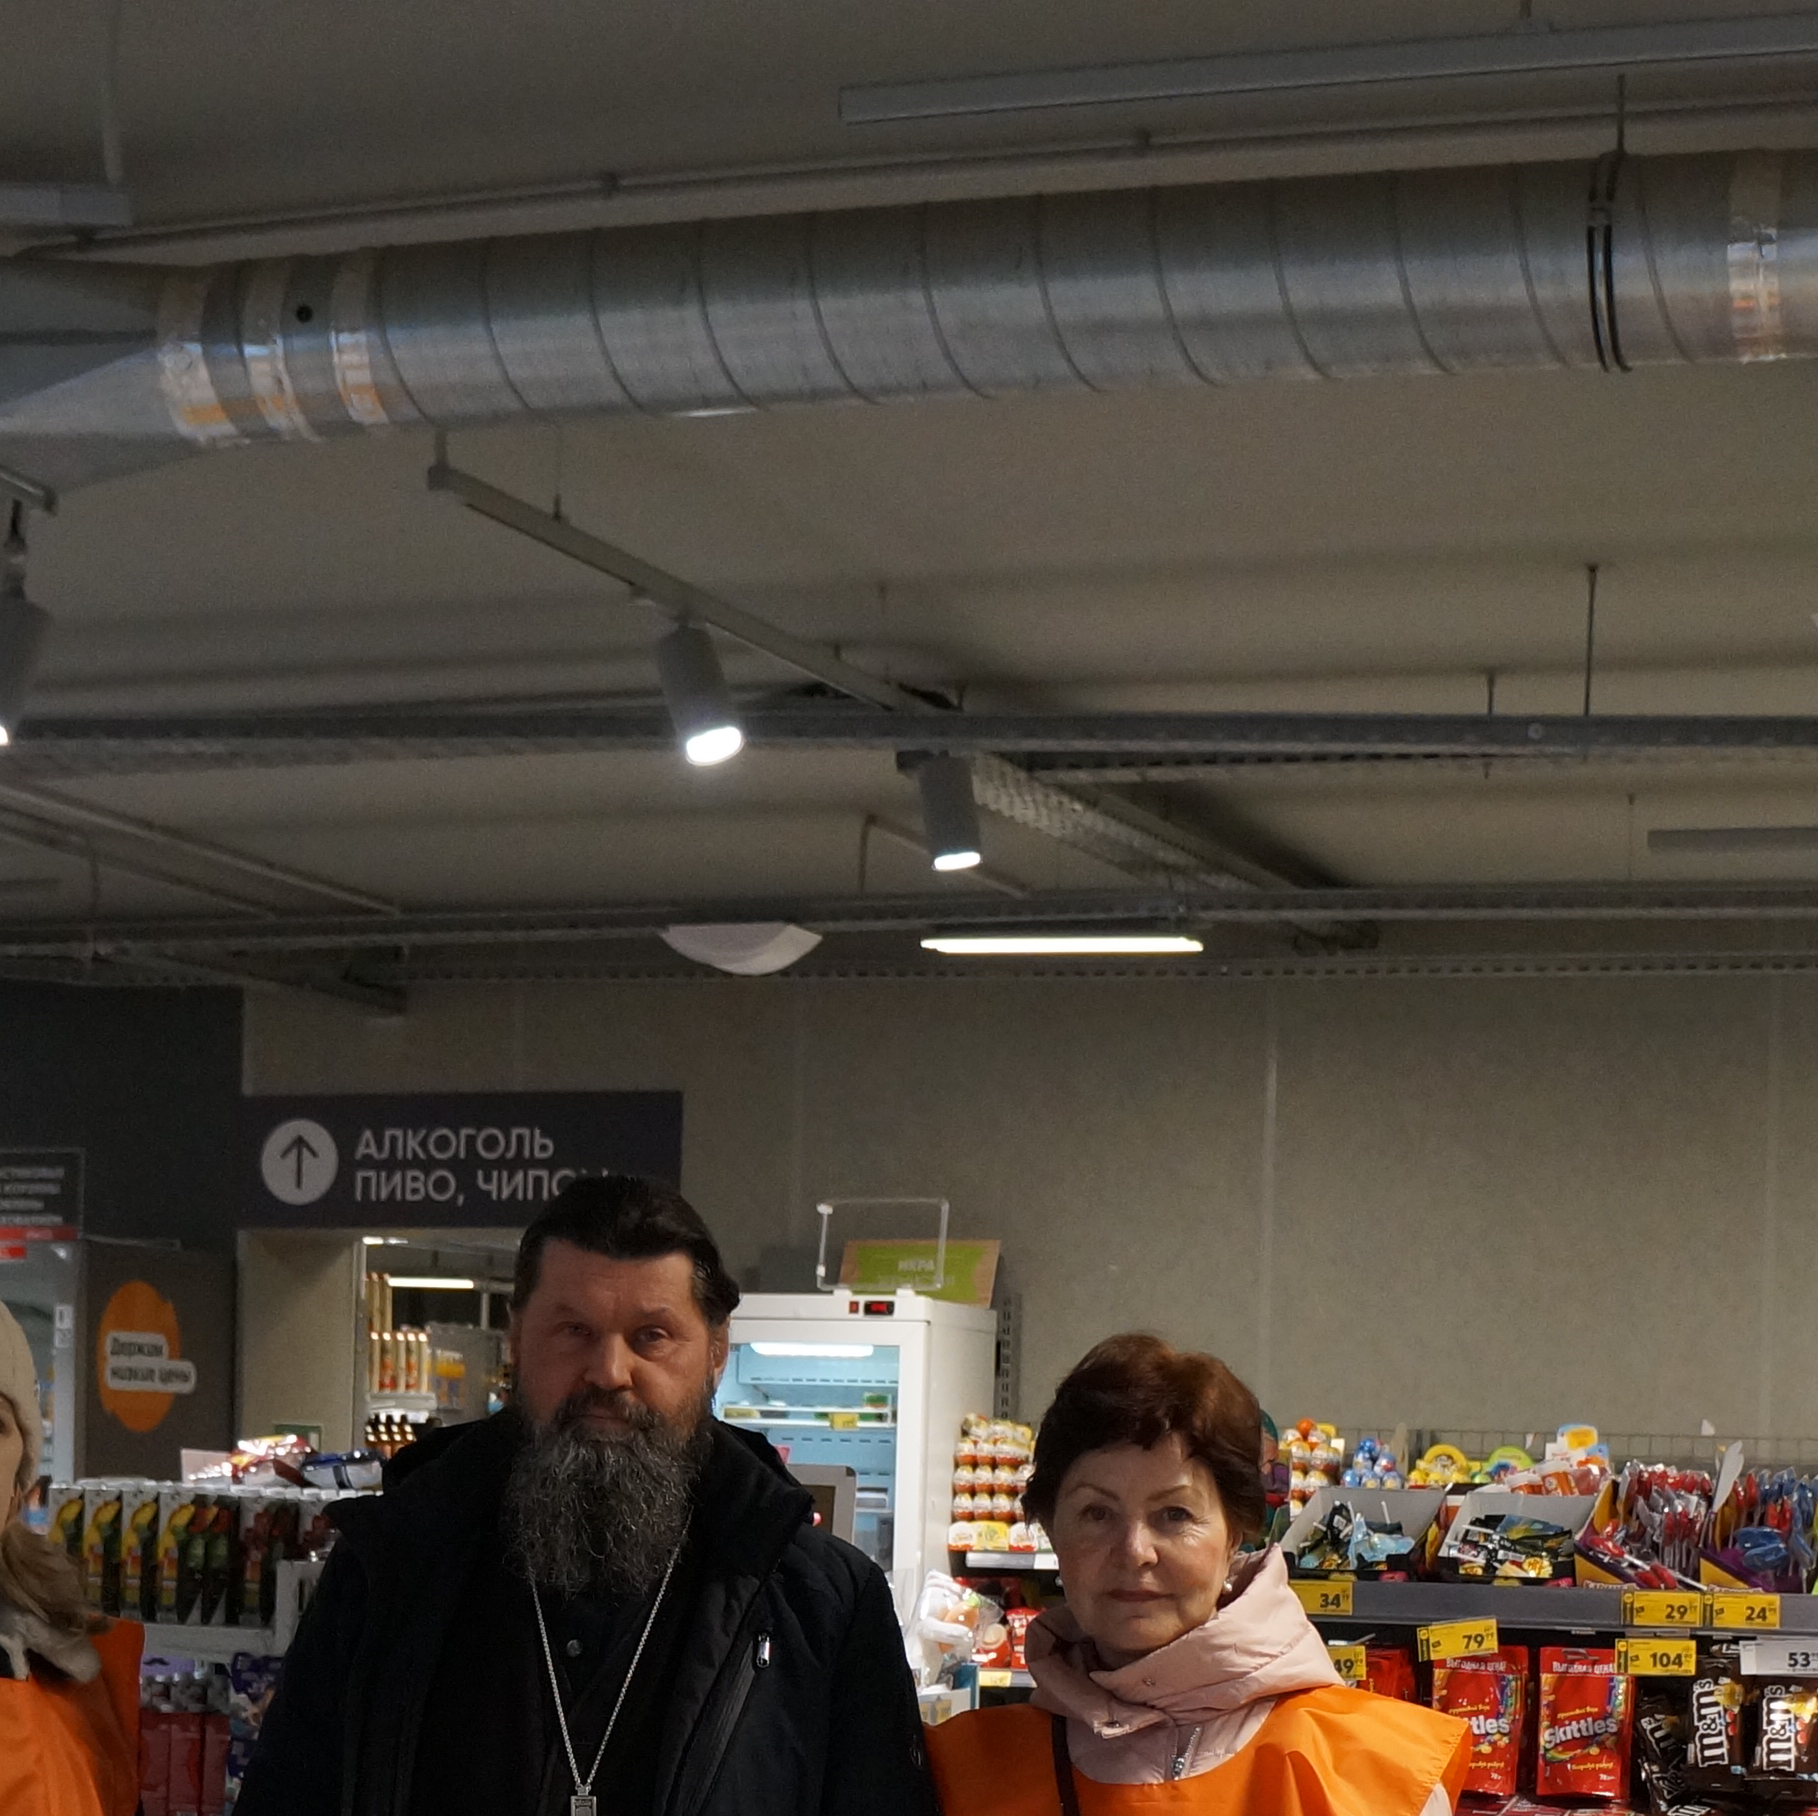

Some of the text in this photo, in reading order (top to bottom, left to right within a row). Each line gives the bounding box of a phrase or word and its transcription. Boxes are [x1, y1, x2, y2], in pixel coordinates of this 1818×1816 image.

[355, 1126, 555, 1160] АЛКОГОЛЬ
[355, 1168, 609, 1207] ПИВО, ЧИПС
[1319, 1593, 1342, 1609] 34
[1665, 1604, 1689, 1620] 29
[1744, 1605, 1768, 1622] 24
[1461, 1633, 1486, 1650] 79
[1649, 1651, 1683, 1669] 104
[1787, 1651, 1811, 1668] 53
[1543, 1715, 1619, 1751] Skittles
